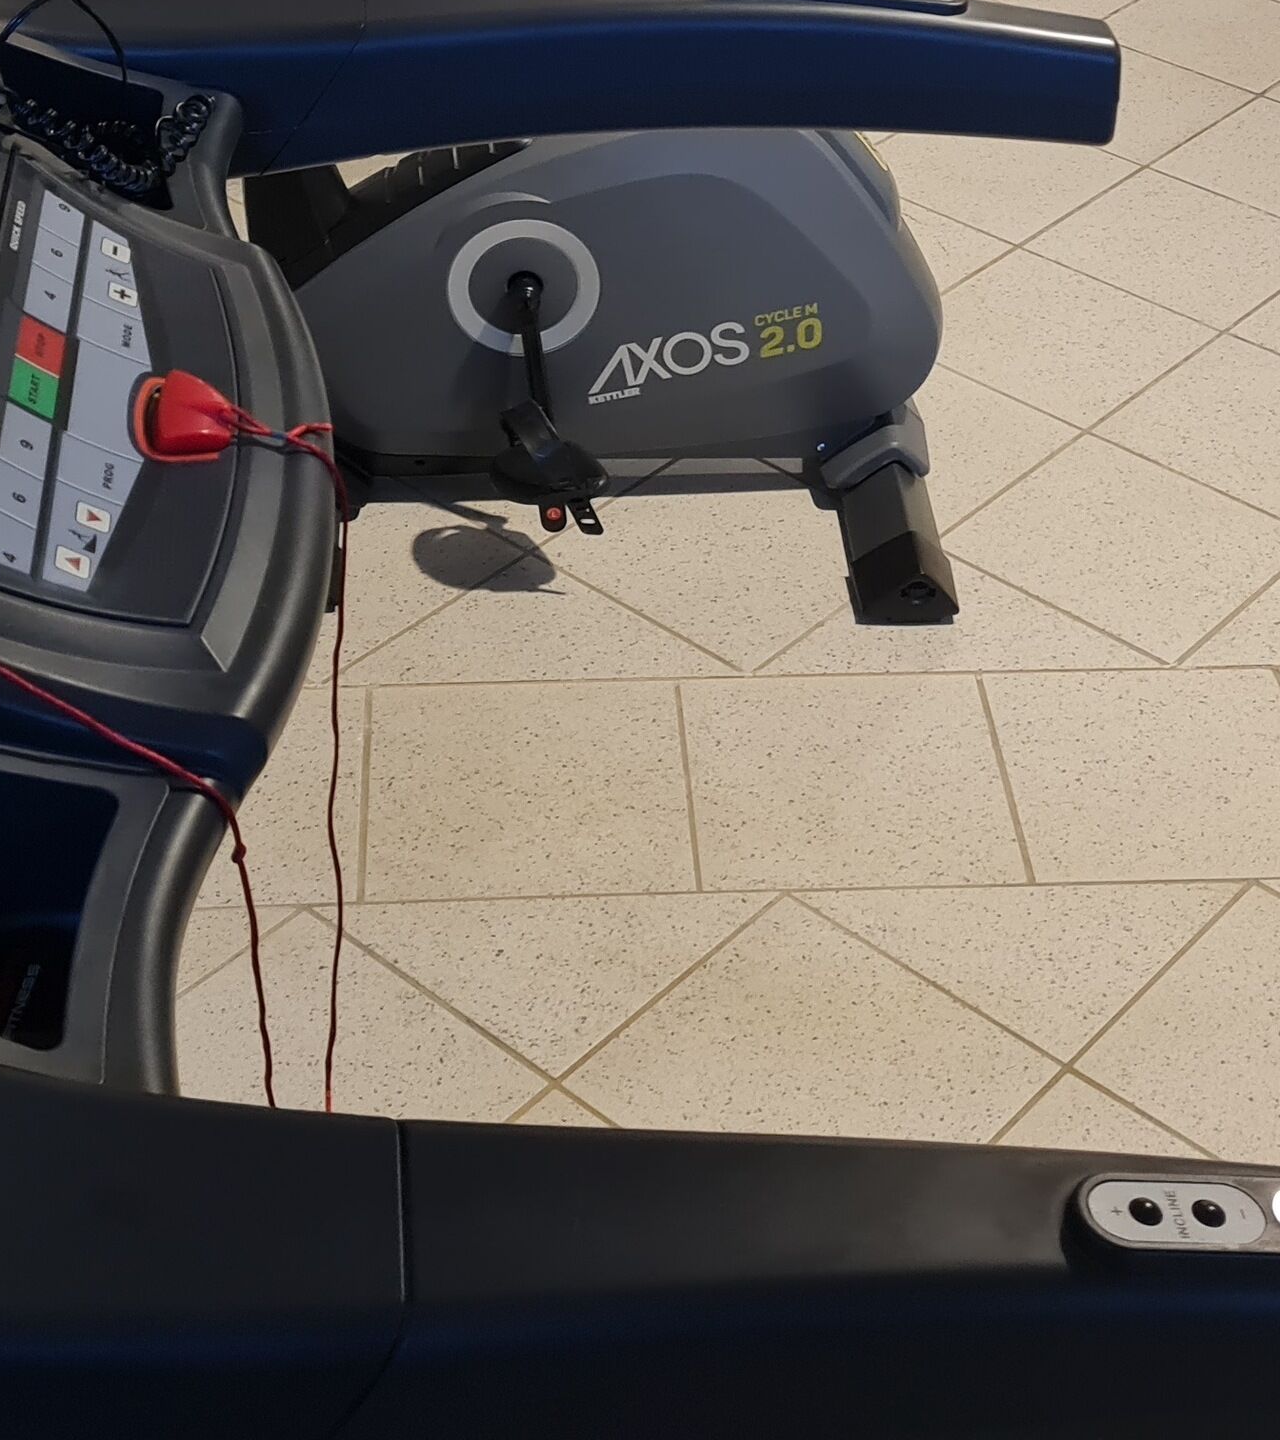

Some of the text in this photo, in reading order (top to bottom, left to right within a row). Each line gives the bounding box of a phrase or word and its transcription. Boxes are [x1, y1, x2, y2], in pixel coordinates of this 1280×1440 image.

[50, 247, 64, 258] 6
[43, 290, 57, 301] 4
[754, 302, 819, 327] CYCLE M
[121, 323, 133, 348] MODE
[759, 317, 823, 359] 2.0
[587, 321, 750, 395] AXOS
[27, 373, 40, 405] START
[587, 387, 641, 405] KETTLER
[19, 439, 34, 451] 9
[102, 462, 115, 490] PROG
[12, 492, 27, 504] 6
[3, 550, 17, 563] 4
[1163, 1189, 1191, 1239] INCLINE
